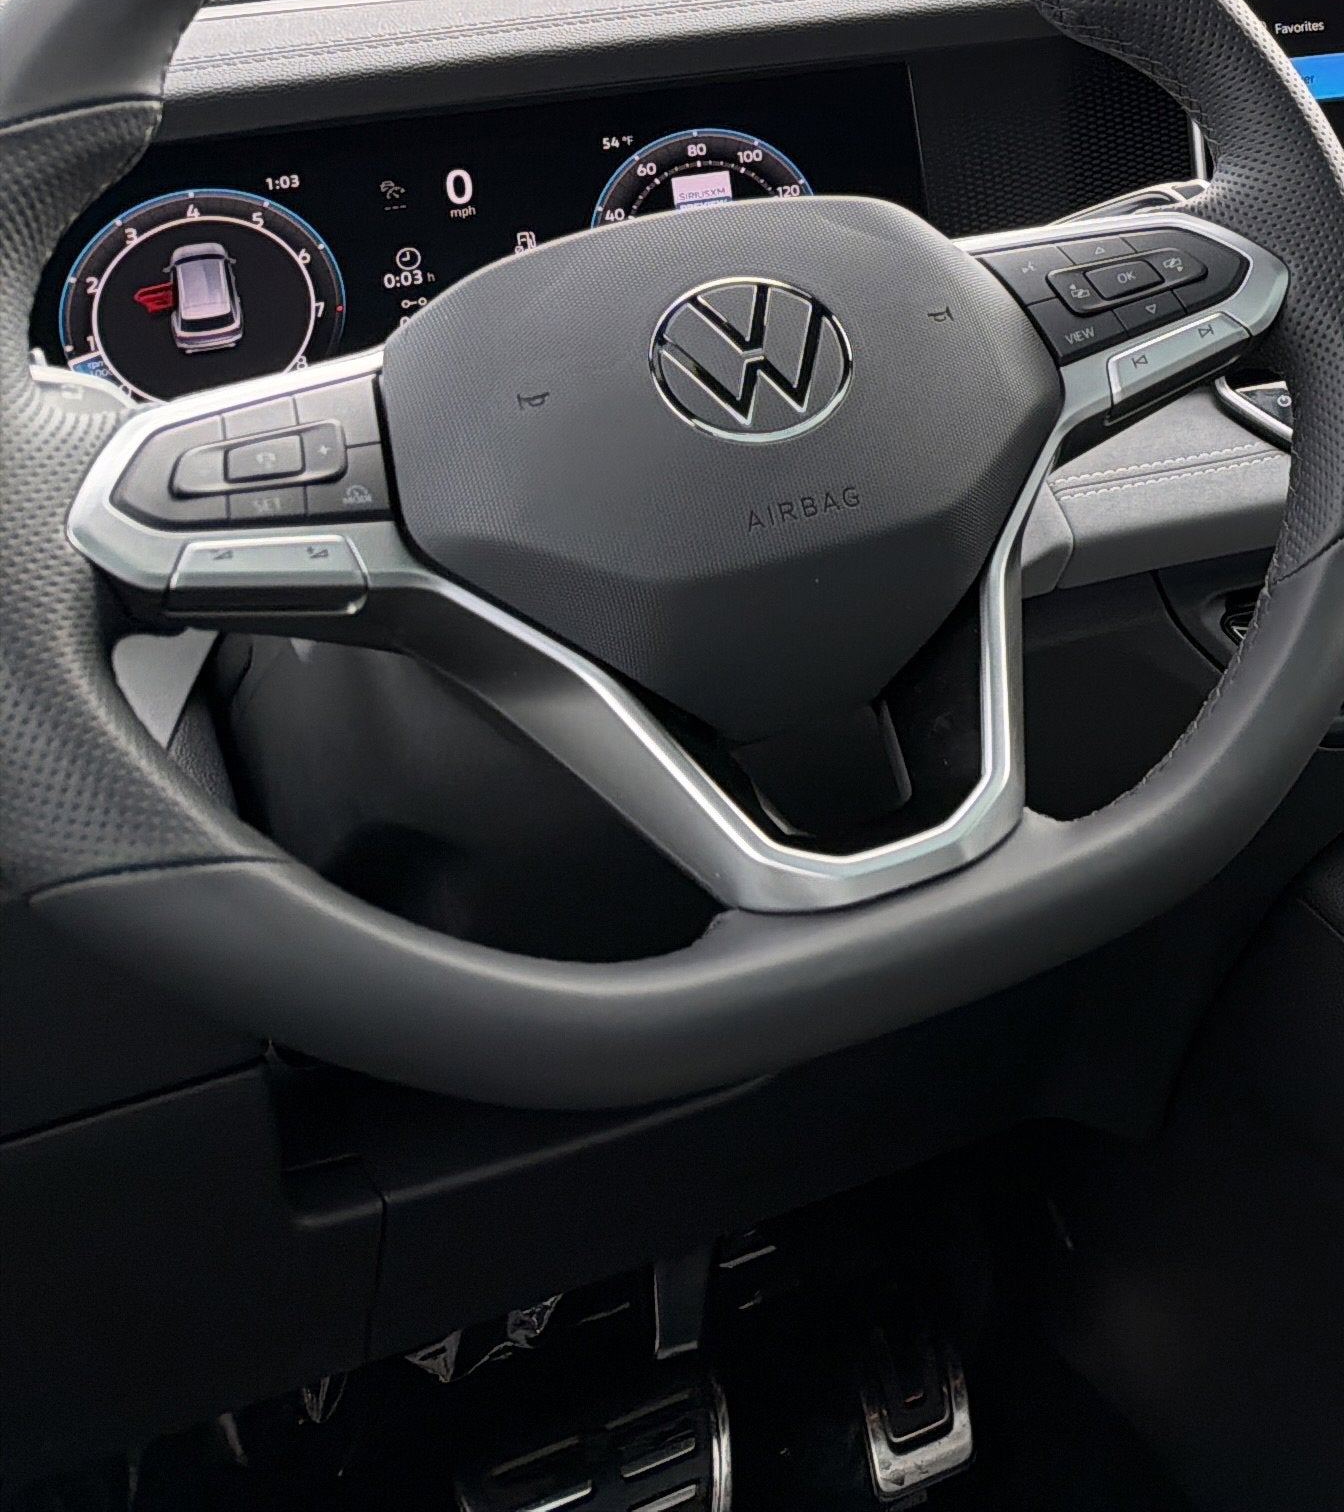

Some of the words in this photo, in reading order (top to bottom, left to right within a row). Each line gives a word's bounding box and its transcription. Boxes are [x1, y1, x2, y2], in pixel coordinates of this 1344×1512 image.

[1275, 19, 1325, 35] Favorites
[602, 136, 620, 150] 54
[687, 143, 707, 157] 80
[737, 149, 763, 164] 100
[636, 162, 657, 177] 60
[265, 174, 300, 191] 1:03
[446, 168, 473, 205] 0
[777, 184, 800, 198] 120
[187, 204, 200, 218] 4
[450, 205, 476, 219] mph
[605, 208, 625, 222] 40
[252, 212, 264, 229] 5
[125, 228, 137, 244] 3
[300, 249, 311, 264] 6
[85, 277, 98, 294] 2
[383, 269, 423, 289] 0:03
[427, 272, 436, 283] h
[1117, 270, 1136, 285] OK
[315, 302, 325, 318] 7
[1065, 326, 1096, 345] VIEW
[86, 336, 95, 352] 1
[650, 278, 851, 440] VW
[253, 498, 281, 513] SET
[749, 486, 860, 531] AIRBAG
